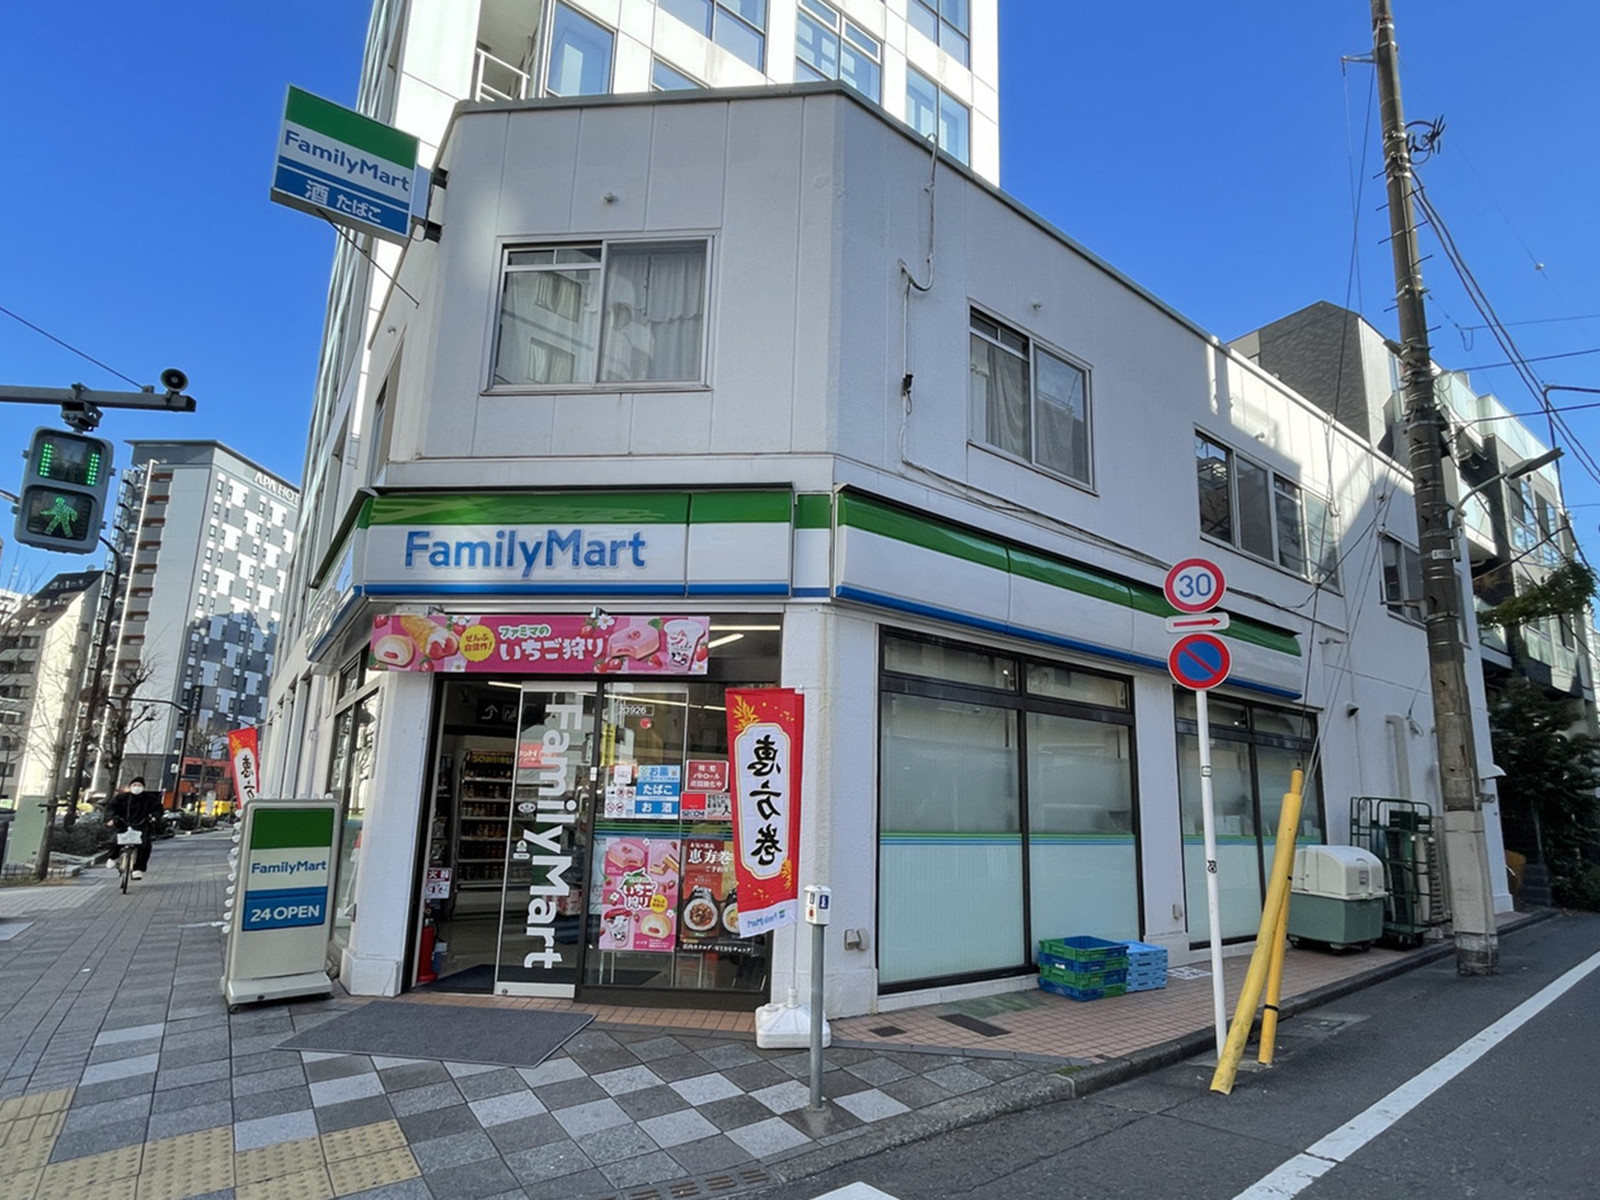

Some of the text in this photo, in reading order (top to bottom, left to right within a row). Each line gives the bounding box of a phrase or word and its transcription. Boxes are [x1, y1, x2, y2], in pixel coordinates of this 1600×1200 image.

[284, 129, 410, 192] FamilyMart
[304, 179, 382, 224] 酒 たばこ
[404, 528, 647, 579] FamilyMart
[1178, 572, 1212, 598] 30
[500, 624, 551, 639] ファミマの
[499, 636, 604, 662] いちご狩り
[642, 783, 673, 795] たばこ
[522, 703, 584, 969] FamilyMart
[251, 859, 327, 875] FamilyMart
[250, 904, 320, 923] 24 OPEN
